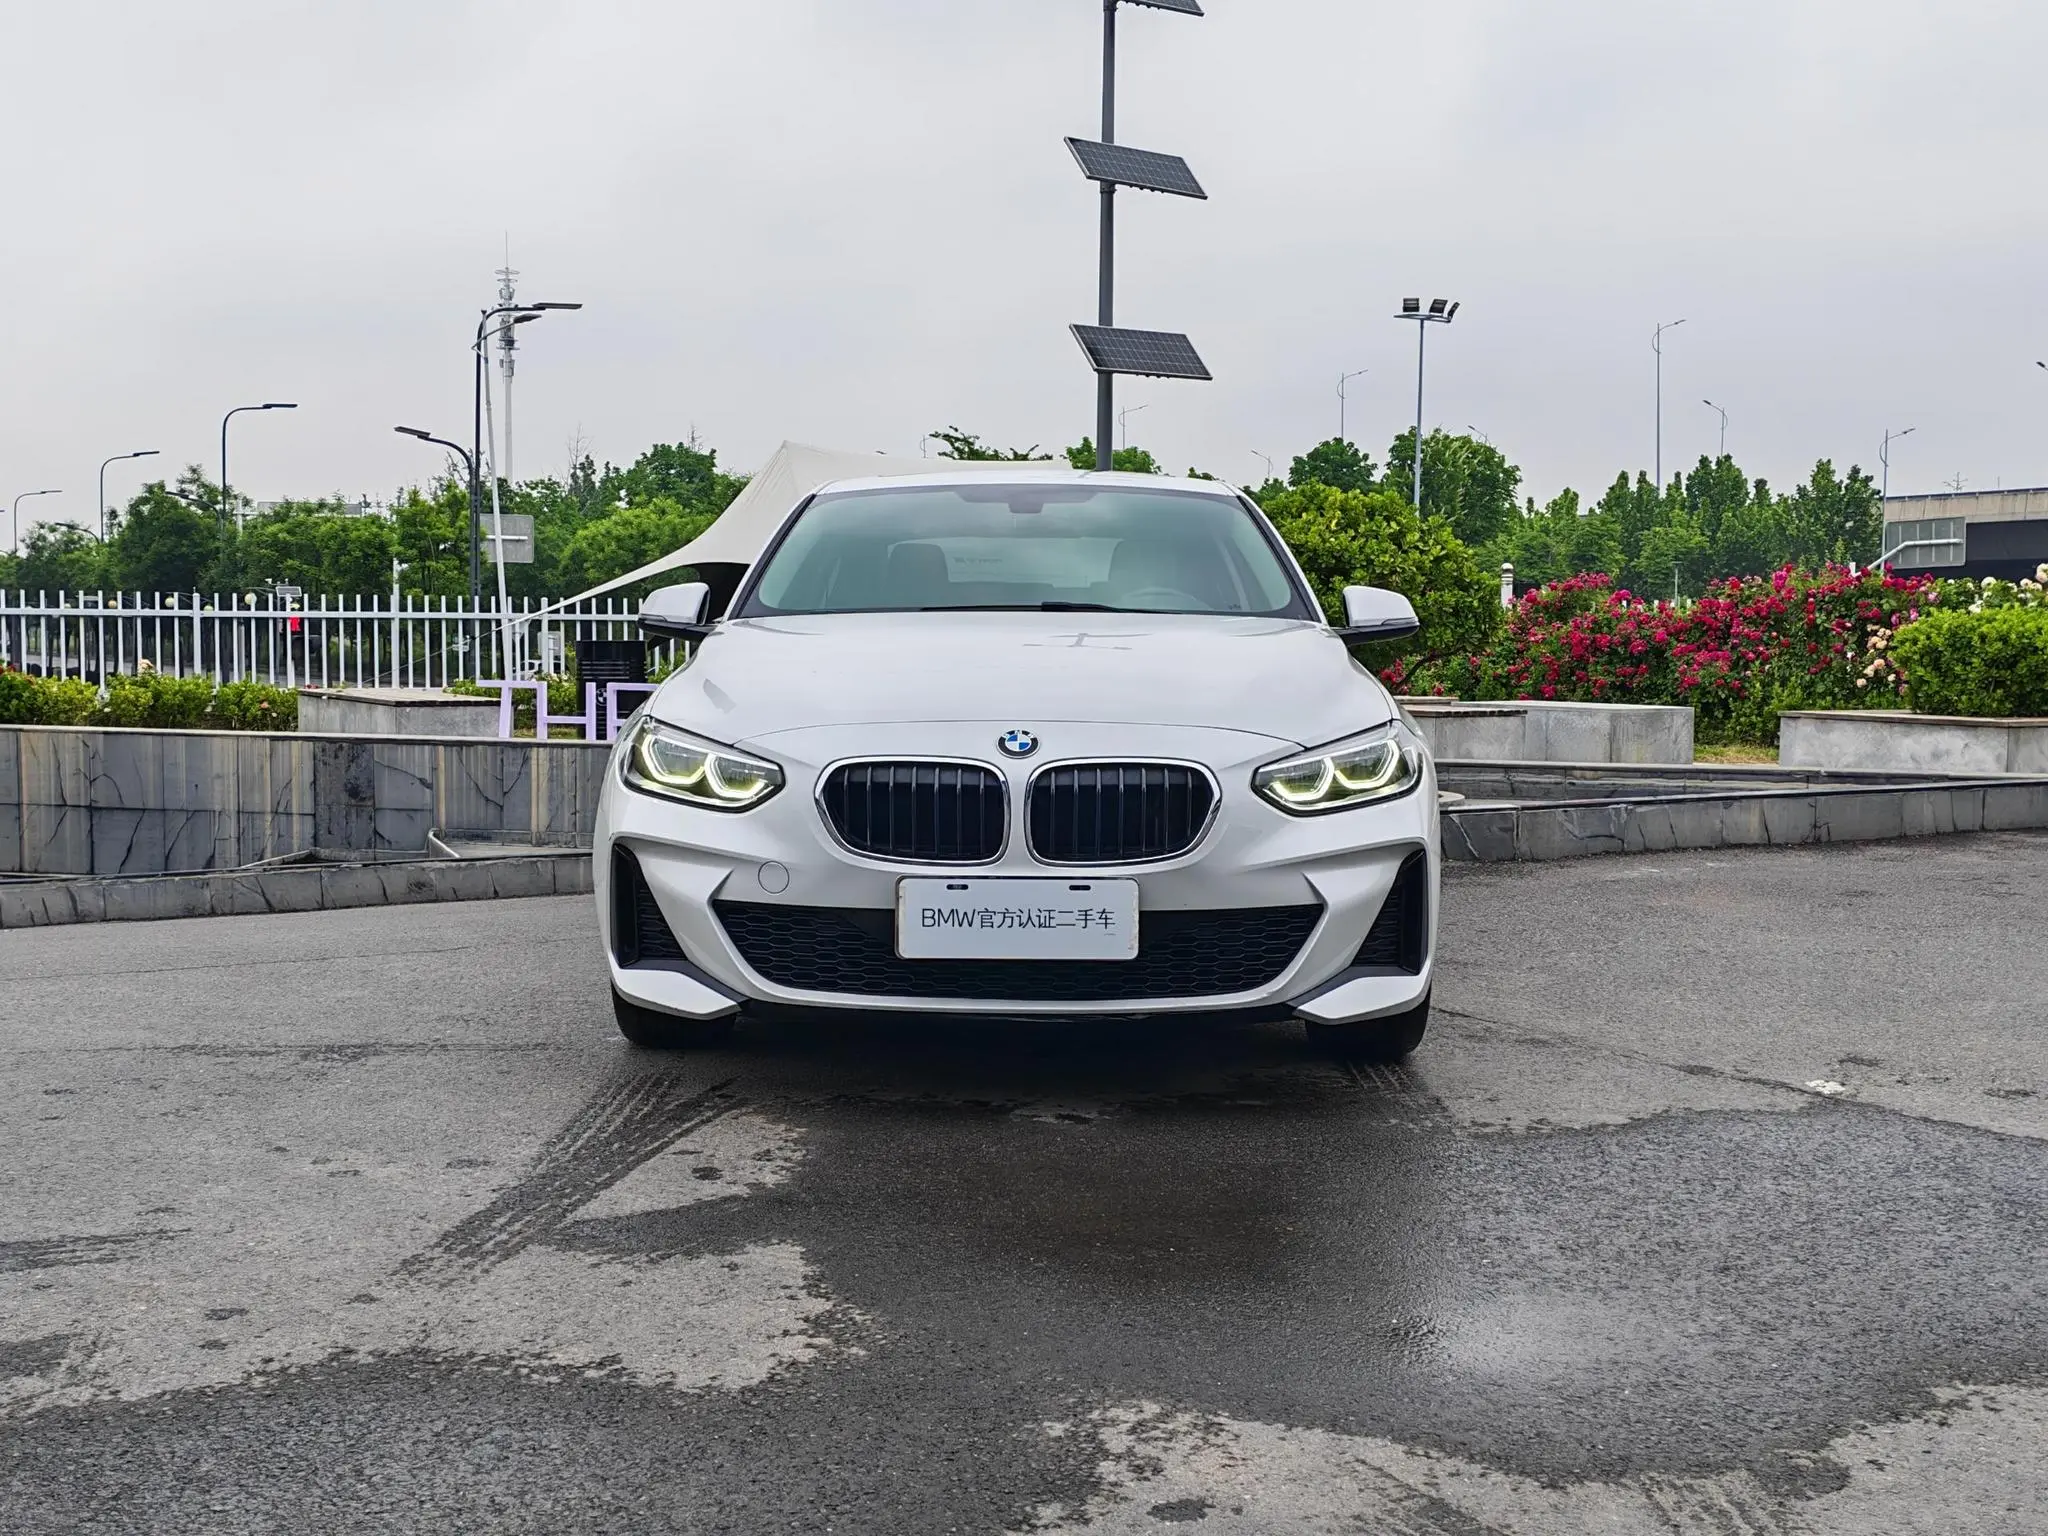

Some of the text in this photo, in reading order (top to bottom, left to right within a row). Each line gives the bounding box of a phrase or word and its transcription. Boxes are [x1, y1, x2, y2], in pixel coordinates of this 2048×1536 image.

[921, 908, 1116, 930] BMW官方认证二手车
